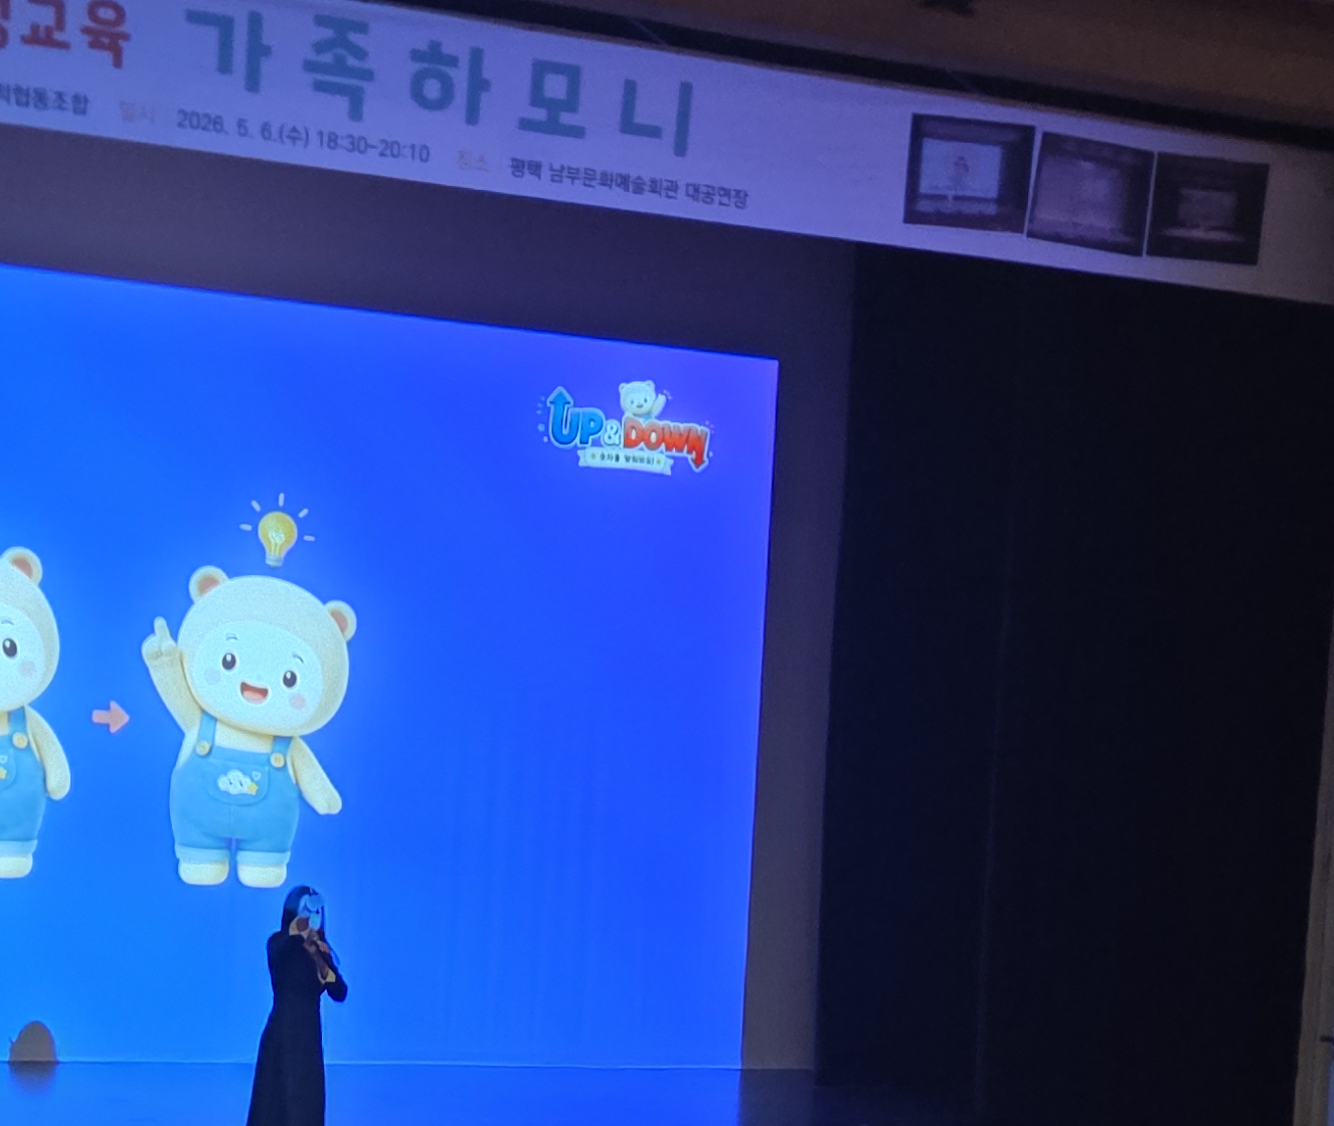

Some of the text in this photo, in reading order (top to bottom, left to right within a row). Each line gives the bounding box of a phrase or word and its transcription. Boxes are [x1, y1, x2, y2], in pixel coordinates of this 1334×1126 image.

[184, 8, 694, 158] 가족하모니
[508, 156, 543, 181] 평택
[548, 162, 679, 200] 남부문화예술회관
[684, 181, 749, 210] 대공연장
